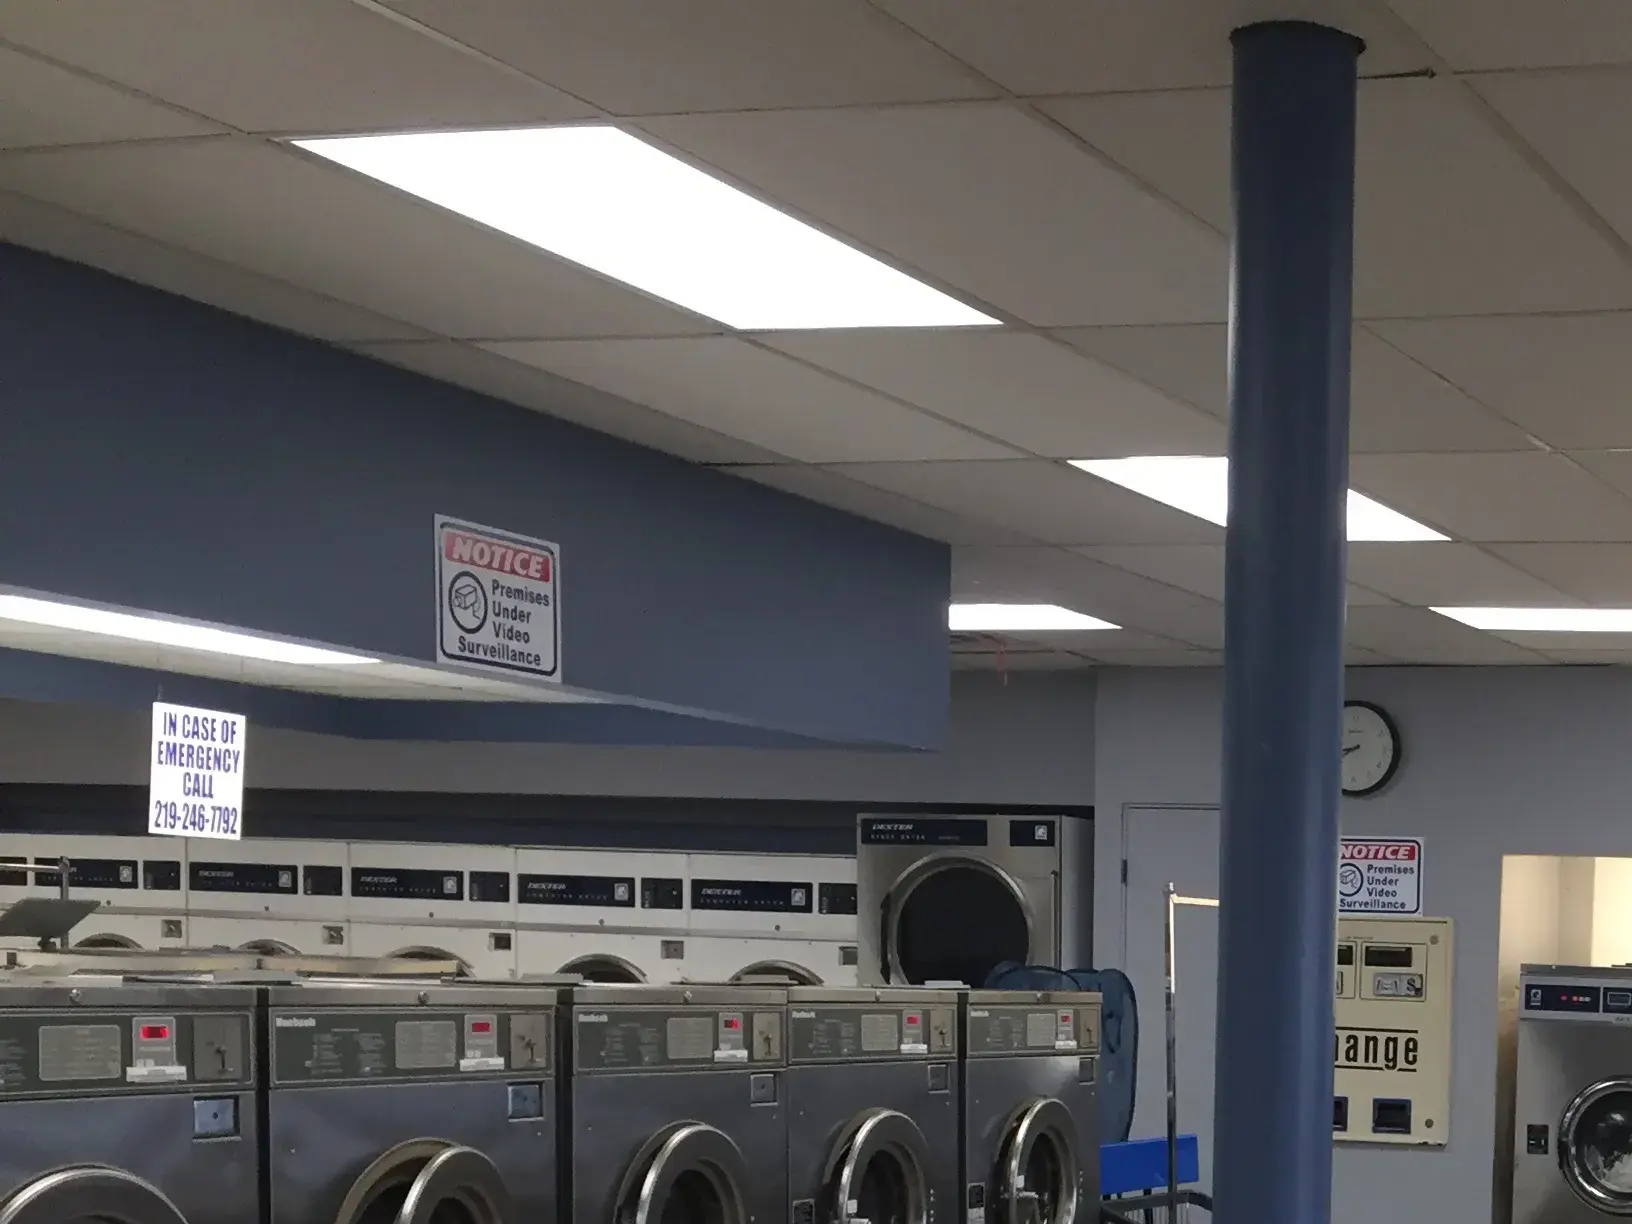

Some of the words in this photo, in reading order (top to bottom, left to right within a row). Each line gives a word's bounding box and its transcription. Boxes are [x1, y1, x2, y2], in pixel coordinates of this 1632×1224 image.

[453, 537, 544, 578] NOTICE
[491, 579, 550, 607] Premises
[492, 602, 532, 624] Under
[492, 621, 531, 644] Video
[458, 635, 542, 666] Surveillance
[163, 711, 178, 737] IN
[182, 714, 217, 742] CASE
[221, 719, 237, 744] OF
[157, 740, 241, 773] EMERGENCY
[183, 772, 214, 798] CALL
[154, 800, 238, 834] 219-246-7792
[872, 823, 915, 831] DEXTER
[1341, 845, 1411, 860] NOTICE
[1366, 863, 1415, 875] Premises
[1366, 876, 1399, 886] Under
[1340, 898, 1407, 910] Surveillance
[1366, 887, 1398, 898] Video
[1335, 1034, 1418, 1071] ange
